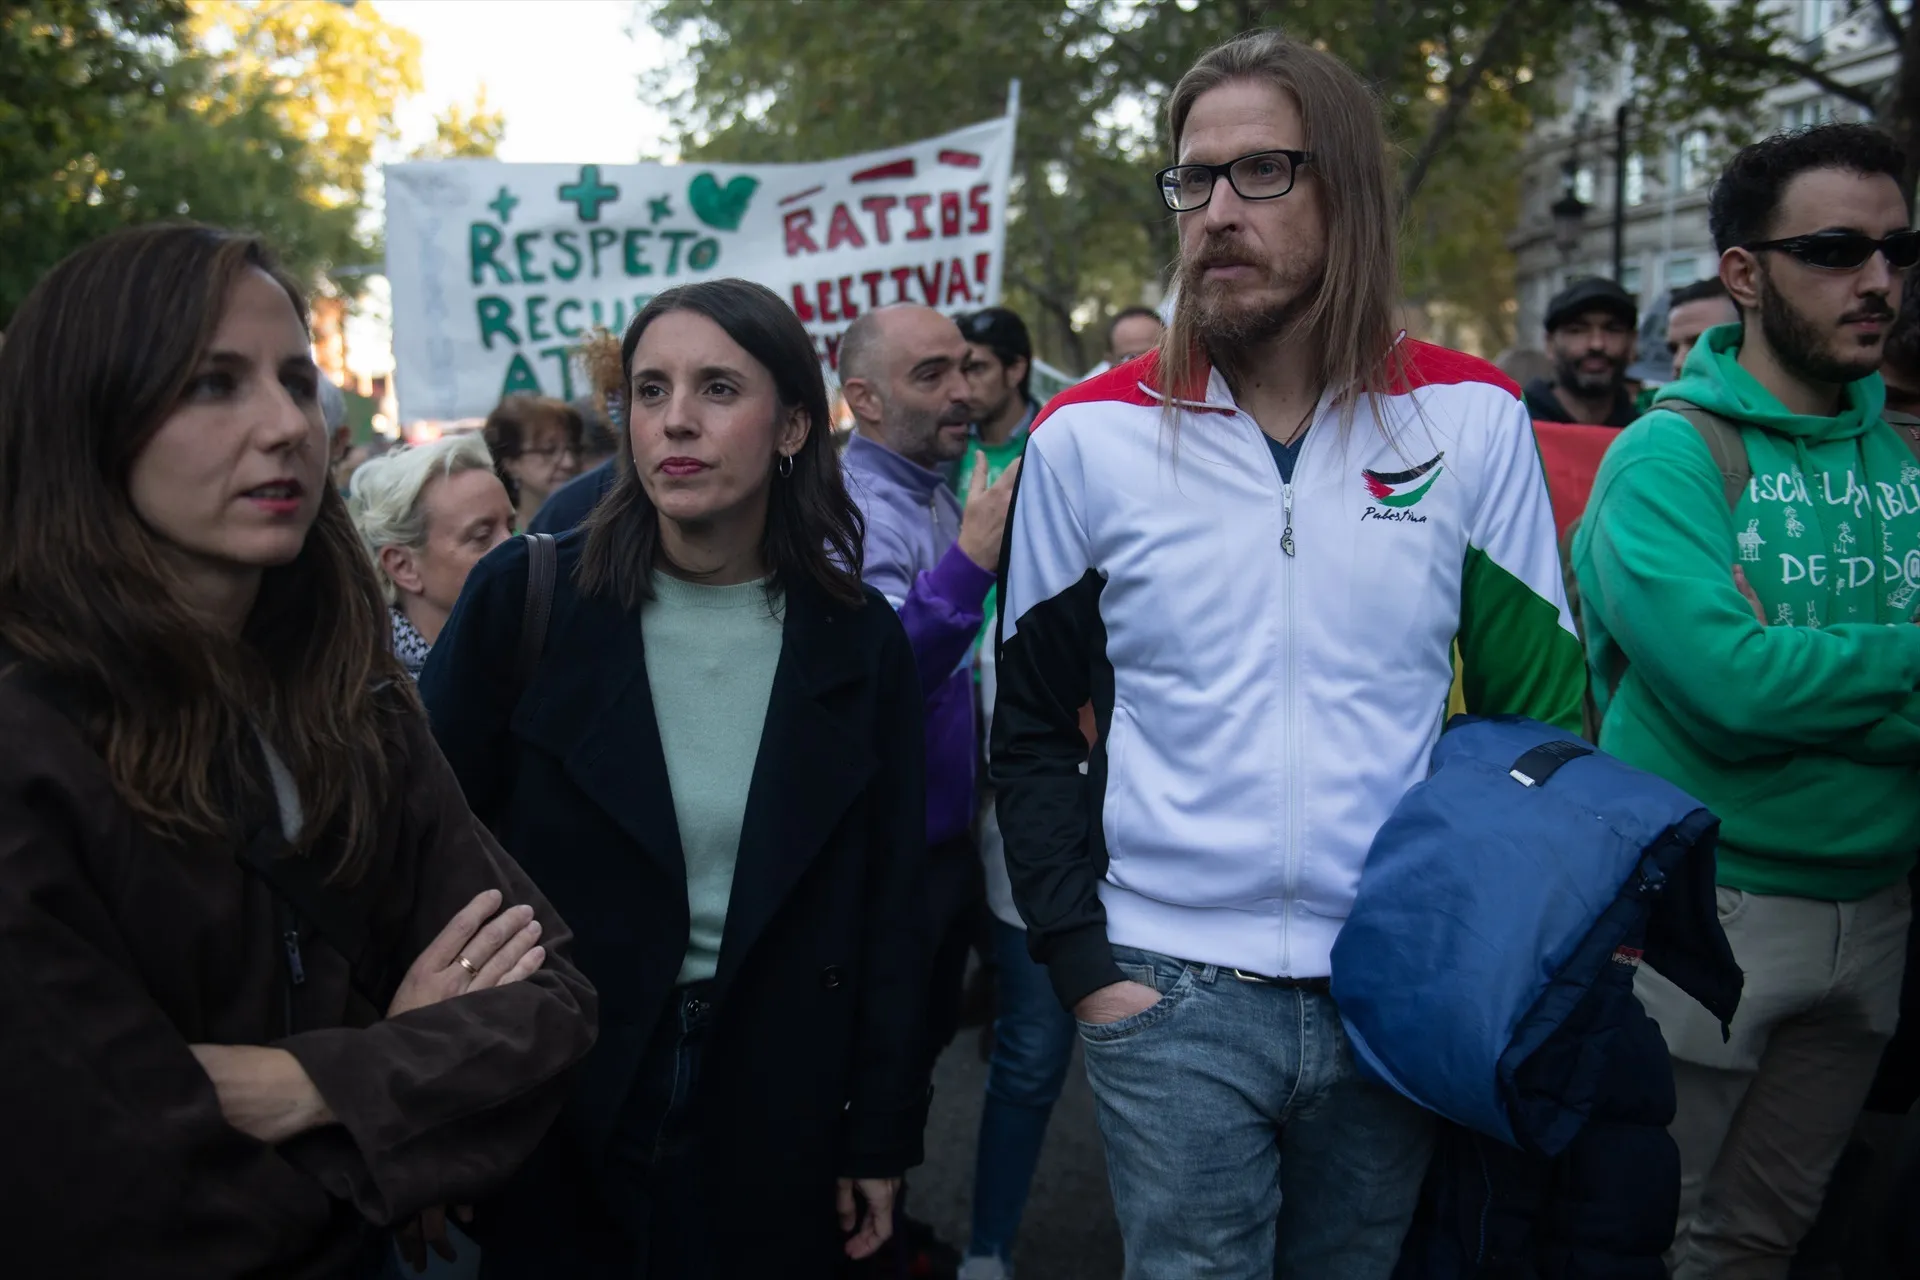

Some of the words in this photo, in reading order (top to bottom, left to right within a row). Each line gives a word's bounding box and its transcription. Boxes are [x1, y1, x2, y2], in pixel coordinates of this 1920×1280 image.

[783, 183, 989, 257] RATIOS
[470, 220, 721, 285] RESPETO
[792, 253, 990, 323] LECTIVA!
[1750, 469, 1855, 506] SCULA
[1361, 506, 1427, 523] Palestina
[1779, 553, 1826, 585] DE
